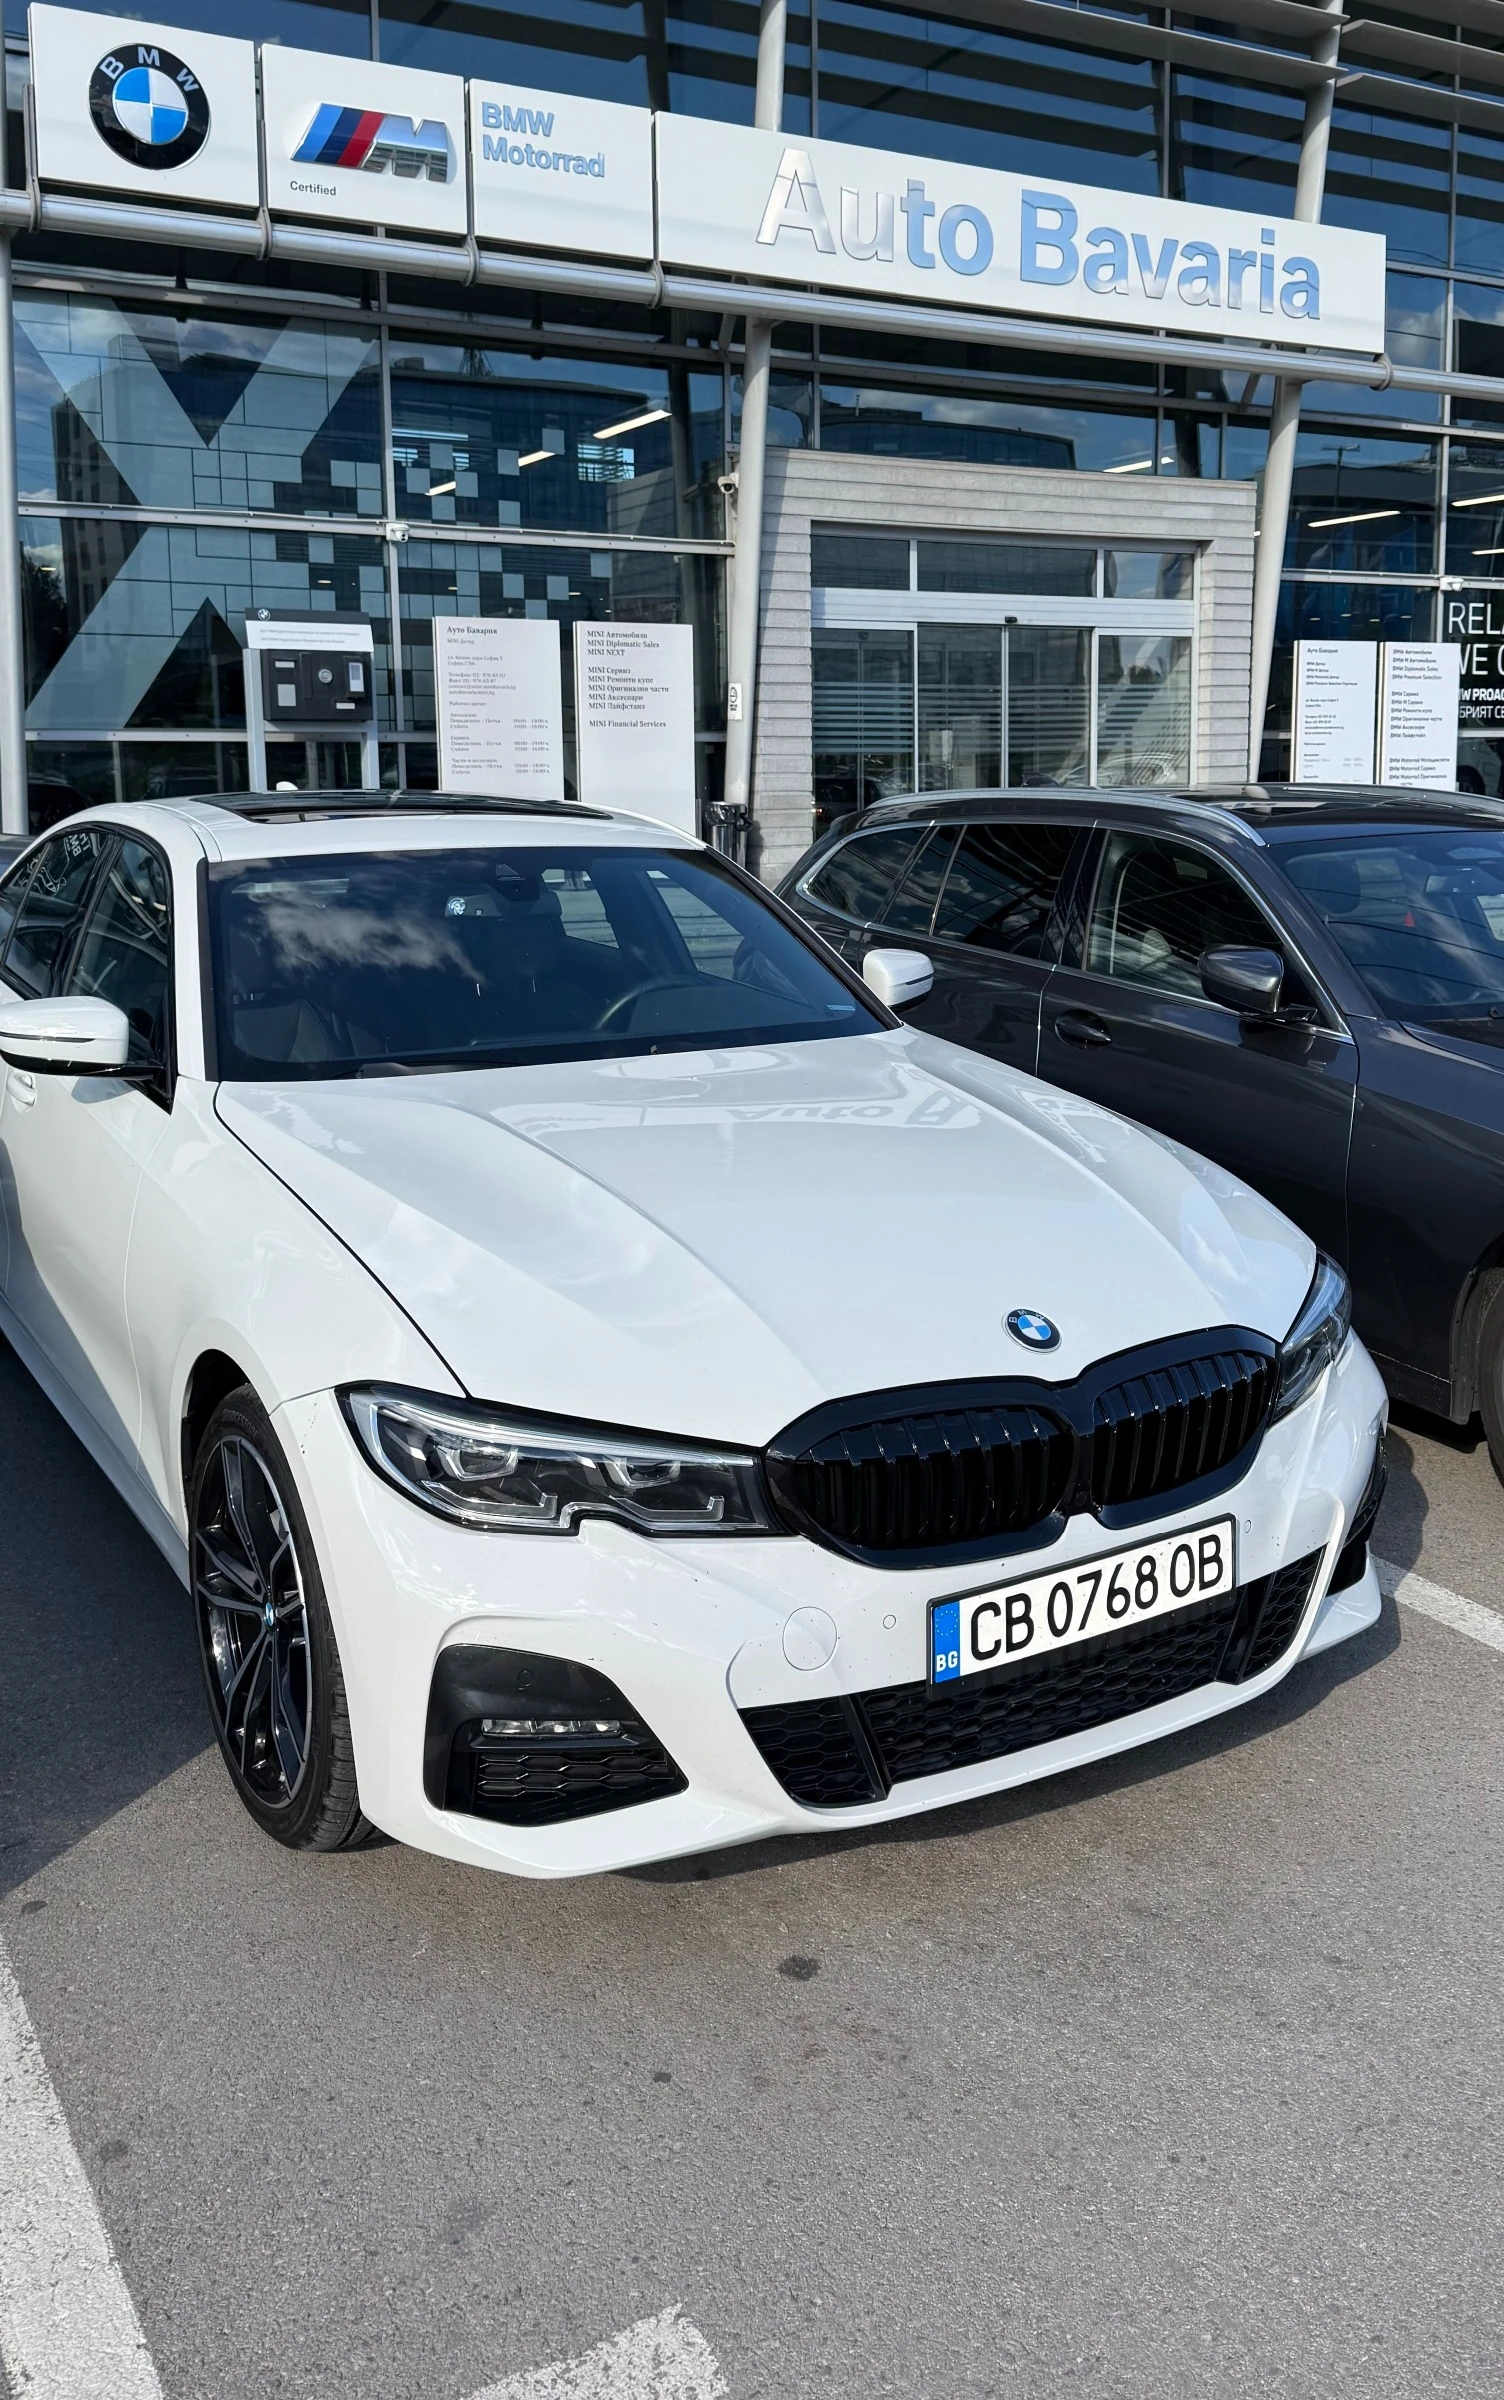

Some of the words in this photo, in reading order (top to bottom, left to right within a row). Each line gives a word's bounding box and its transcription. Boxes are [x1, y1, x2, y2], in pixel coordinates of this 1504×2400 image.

[100, 46, 200, 93] BMW
[482, 101, 555, 137] BMW
[482, 135, 606, 178] Motorrad
[290, 180, 337, 197] Certified
[756, 148, 994, 276] Auto
[1019, 188, 1321, 321] Bavaria
[1448, 602, 1504, 635] REL
[447, 626, 465, 634] Ауто
[467, 626, 497, 635] Бавария
[606, 640, 641, 648] Diplomatic
[607, 667, 631, 675] Сервиз
[607, 685, 648, 693] Оригинални
[1008, 1309, 1045, 1324] BMW
[970, 1592, 1034, 1661] CB
[1046, 1555, 1159, 1638] 0768
[936, 1650, 958, 1672] BG
